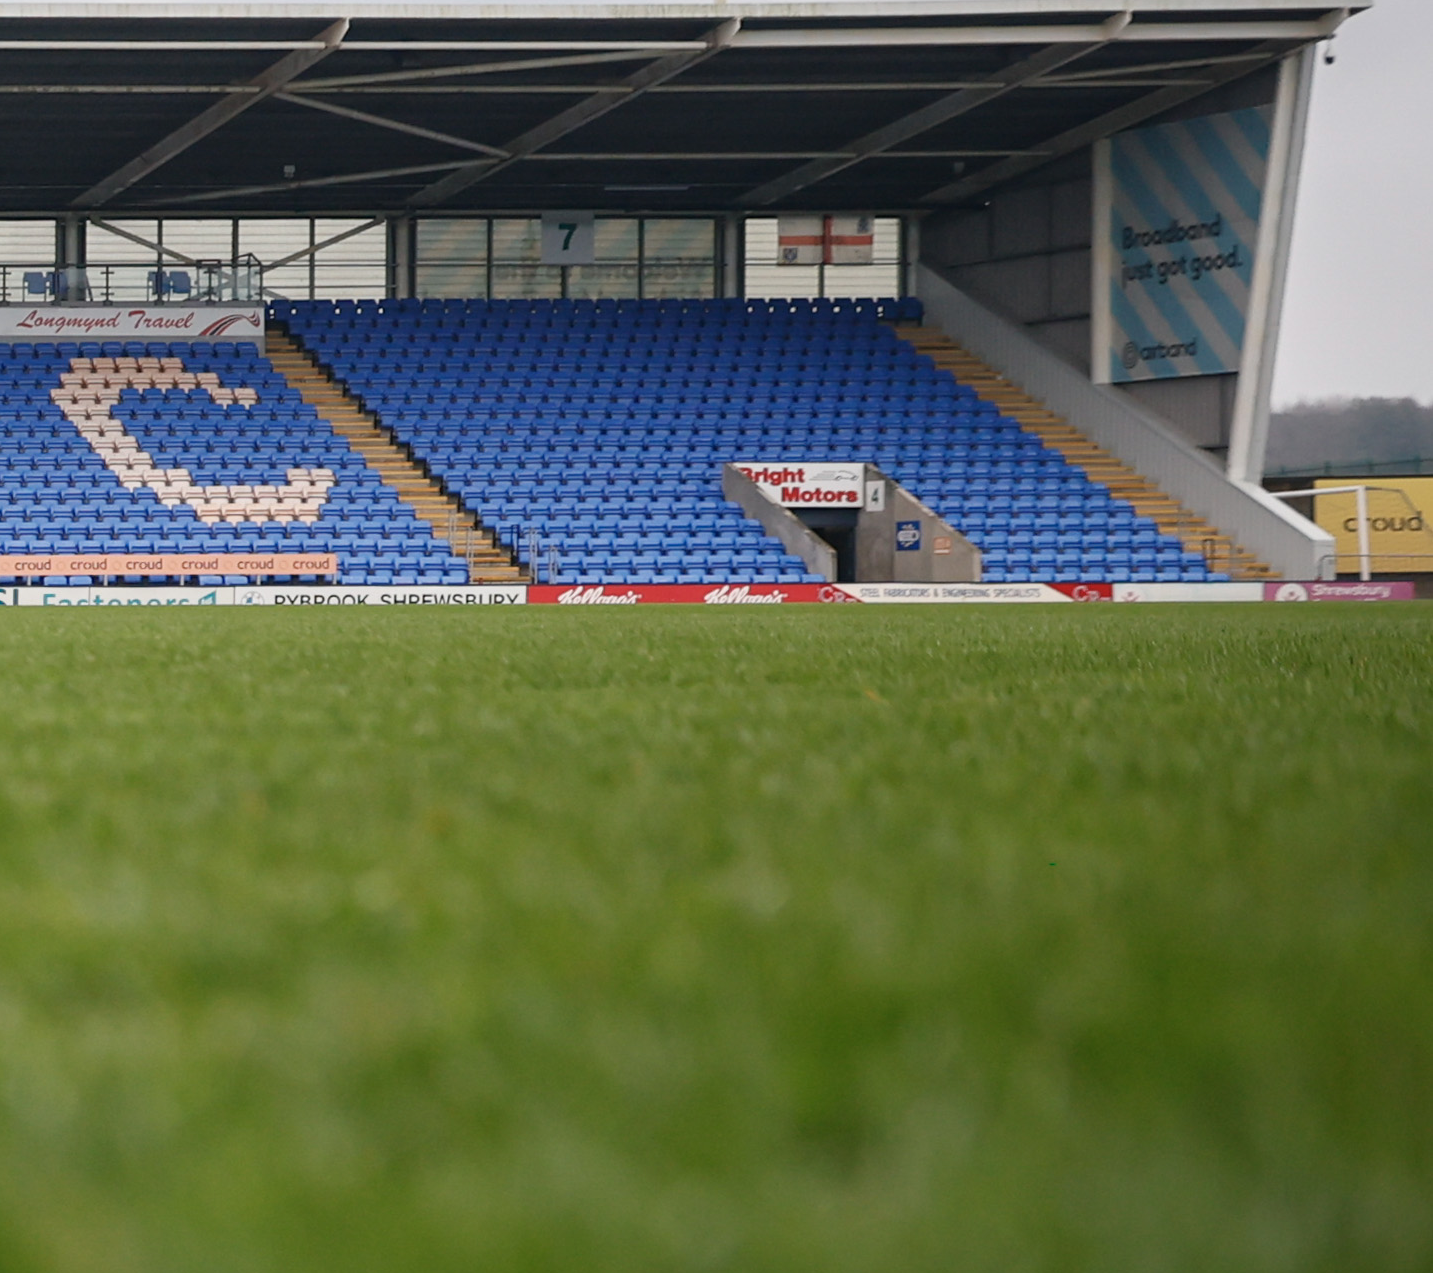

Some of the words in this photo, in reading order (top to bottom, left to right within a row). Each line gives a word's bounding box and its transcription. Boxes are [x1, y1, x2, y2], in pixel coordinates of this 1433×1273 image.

[558, 223, 577, 250] 7
[1122, 213, 1221, 249] Broadband
[1157, 256, 1187, 284] got
[16, 310, 122, 333] Longmynd
[128, 309, 195, 328] Travel
[781, 487, 858, 502] Motors
[871, 488, 879, 502] 4
[1344, 511, 1423, 532] coud
[15, 560, 52, 571] croud
[70, 560, 107, 571] croud
[126, 558, 163, 570] croud
[182, 558, 219, 570] croud
[237, 558, 274, 570] croud
[293, 558, 330, 570] croud
